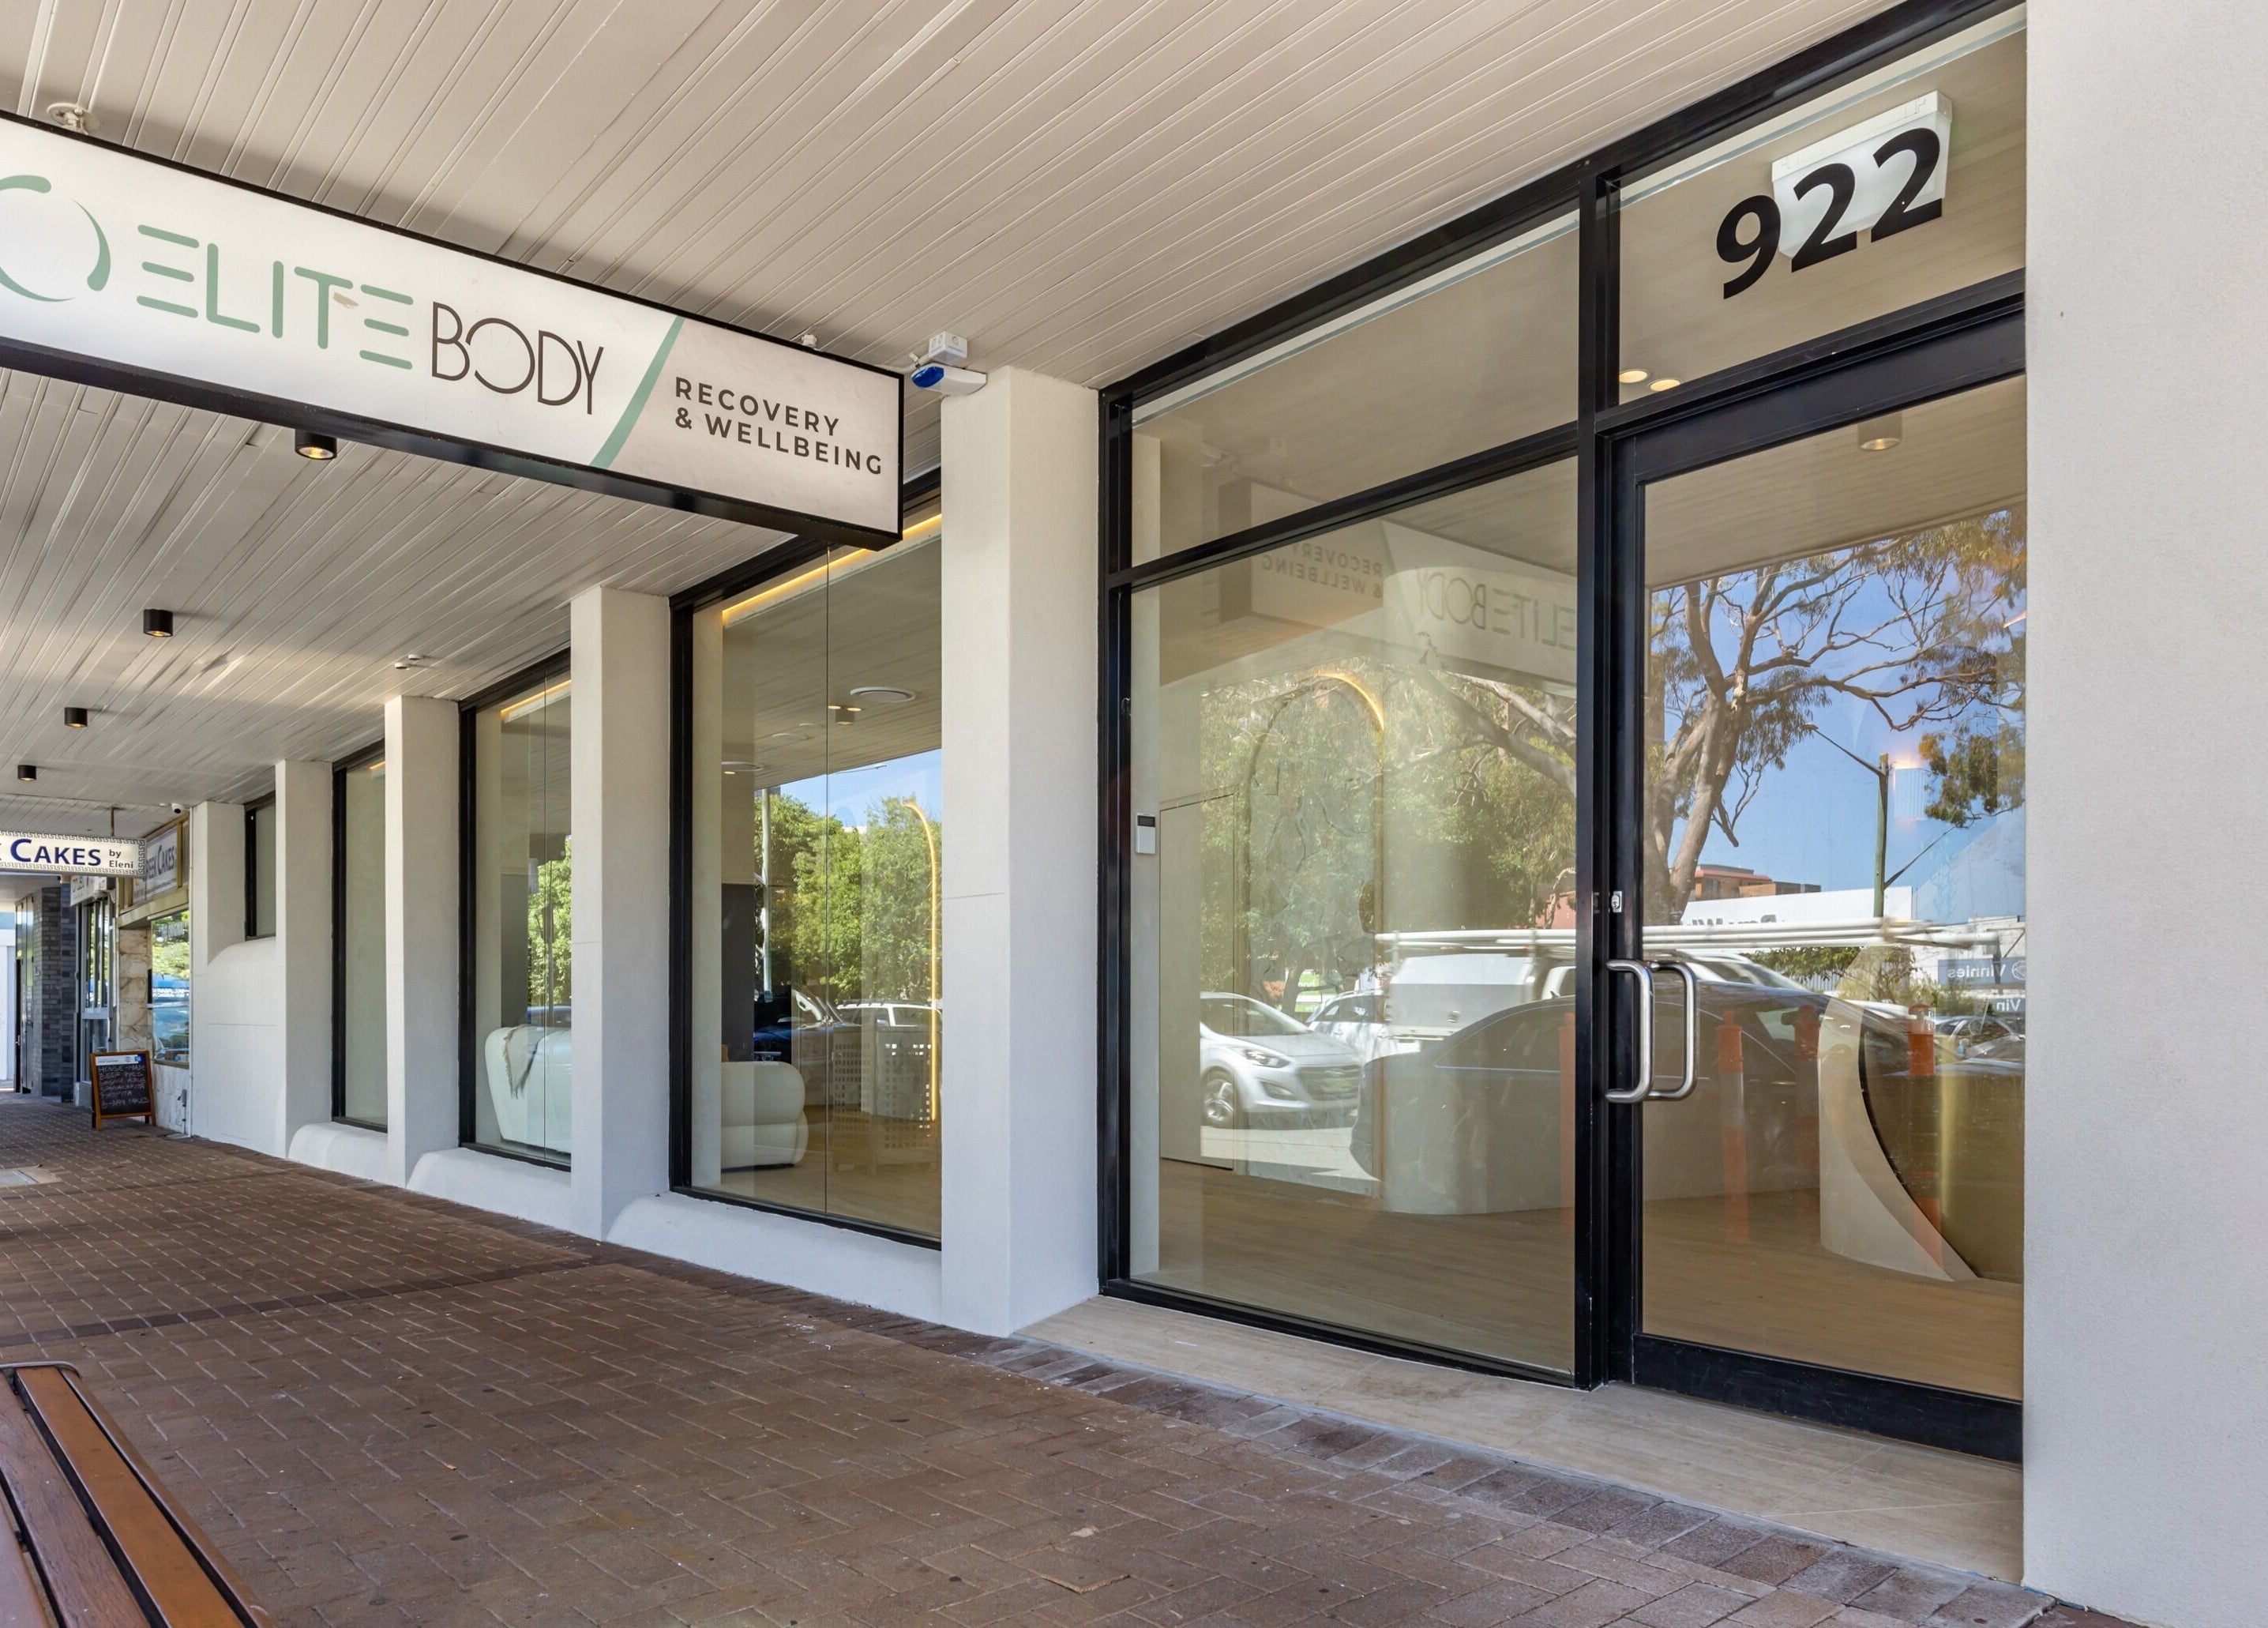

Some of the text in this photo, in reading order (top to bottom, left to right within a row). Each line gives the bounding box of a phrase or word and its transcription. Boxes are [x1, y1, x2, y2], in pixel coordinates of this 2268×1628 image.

[1716, 127, 1943, 299] 922
[137, 224, 604, 415] ELITE BODY
[676, 376, 840, 437] RECOVERY
[675, 407, 882, 475] & WELLBEING
[10, 838, 101, 866] CAKES
[109, 848, 122, 859] by
[109, 859, 133, 869] Eleni
